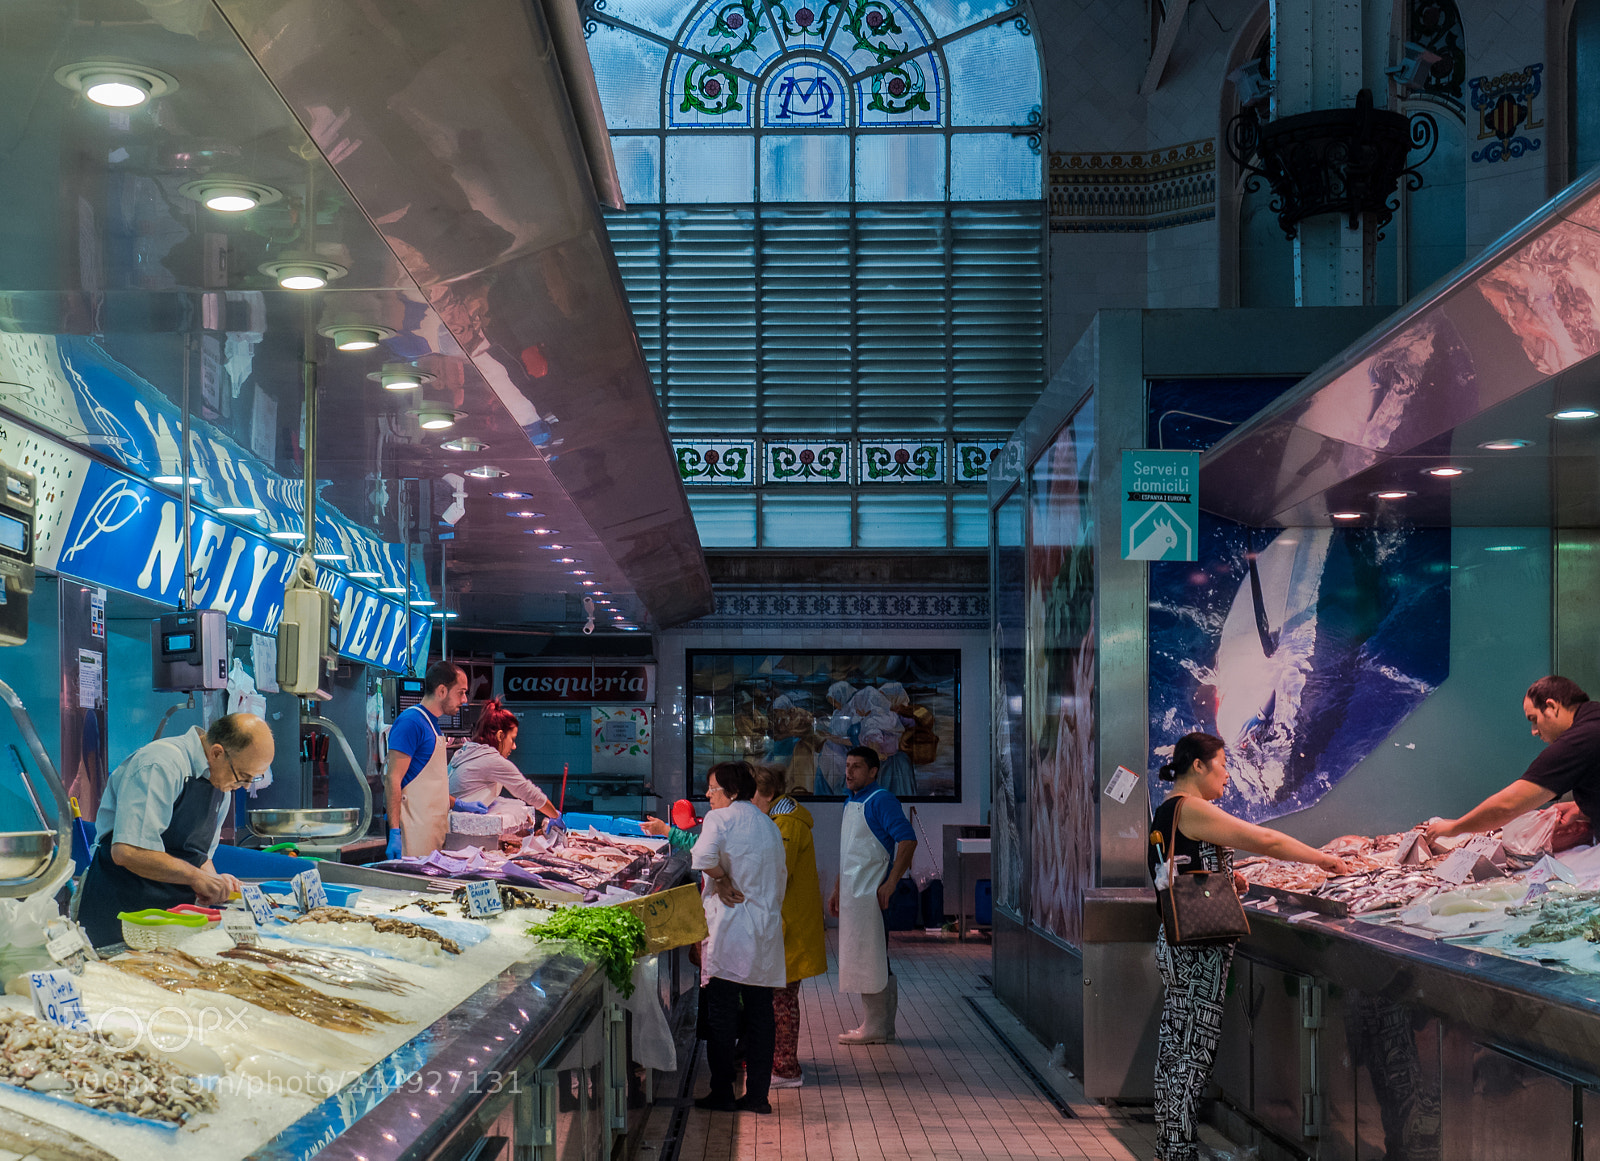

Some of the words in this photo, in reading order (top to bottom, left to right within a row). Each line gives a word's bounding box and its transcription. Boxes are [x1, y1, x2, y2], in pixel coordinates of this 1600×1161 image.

[1134, 461, 1176, 475] Servei
[1181, 466, 1189, 476] a
[1133, 478, 1189, 492] domicili
[137, 501, 279, 622] NELY
[340, 586, 407, 666] NELY
[508, 670, 645, 697] casquería
